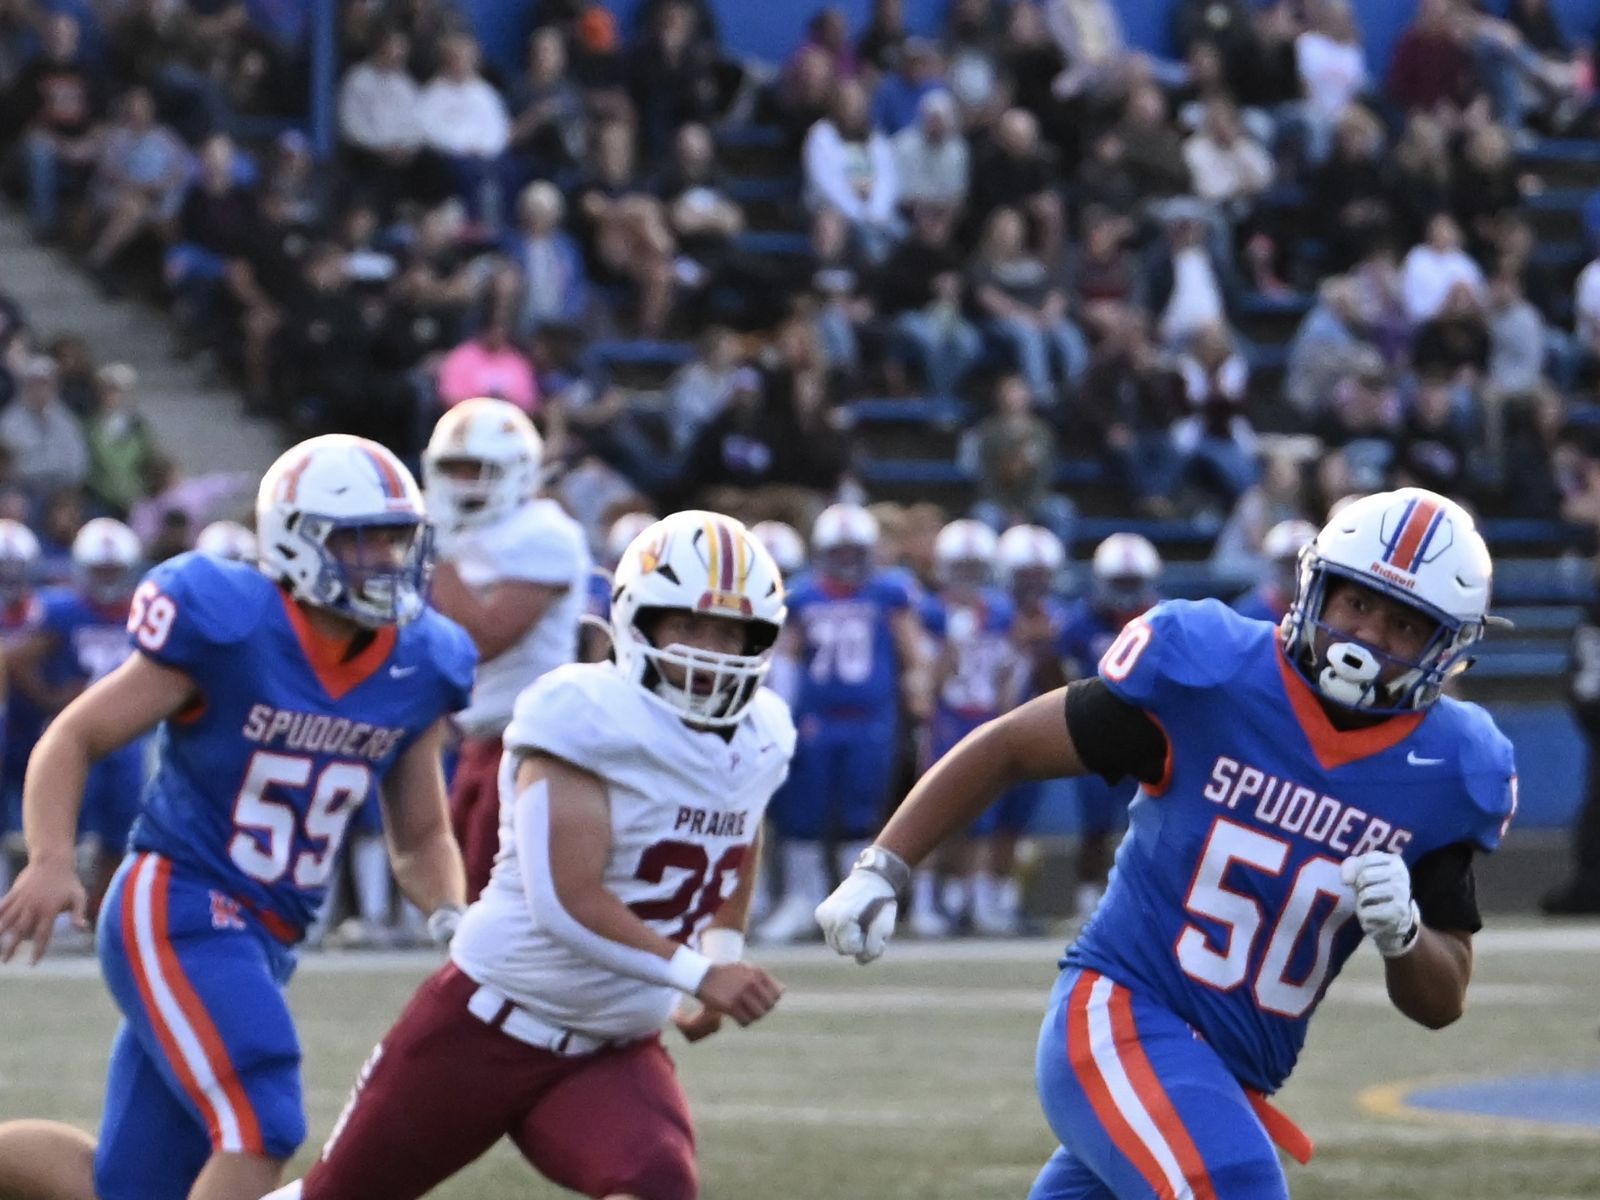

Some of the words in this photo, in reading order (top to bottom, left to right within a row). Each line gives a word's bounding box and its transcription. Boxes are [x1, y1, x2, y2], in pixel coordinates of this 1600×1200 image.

[1369, 562, 1416, 589] Riddell
[243, 703, 405, 762] SPUDDERS
[228, 749, 372, 889] 59
[1203, 755, 1414, 856] SPUDDERS
[1174, 814, 1364, 1020] 50
